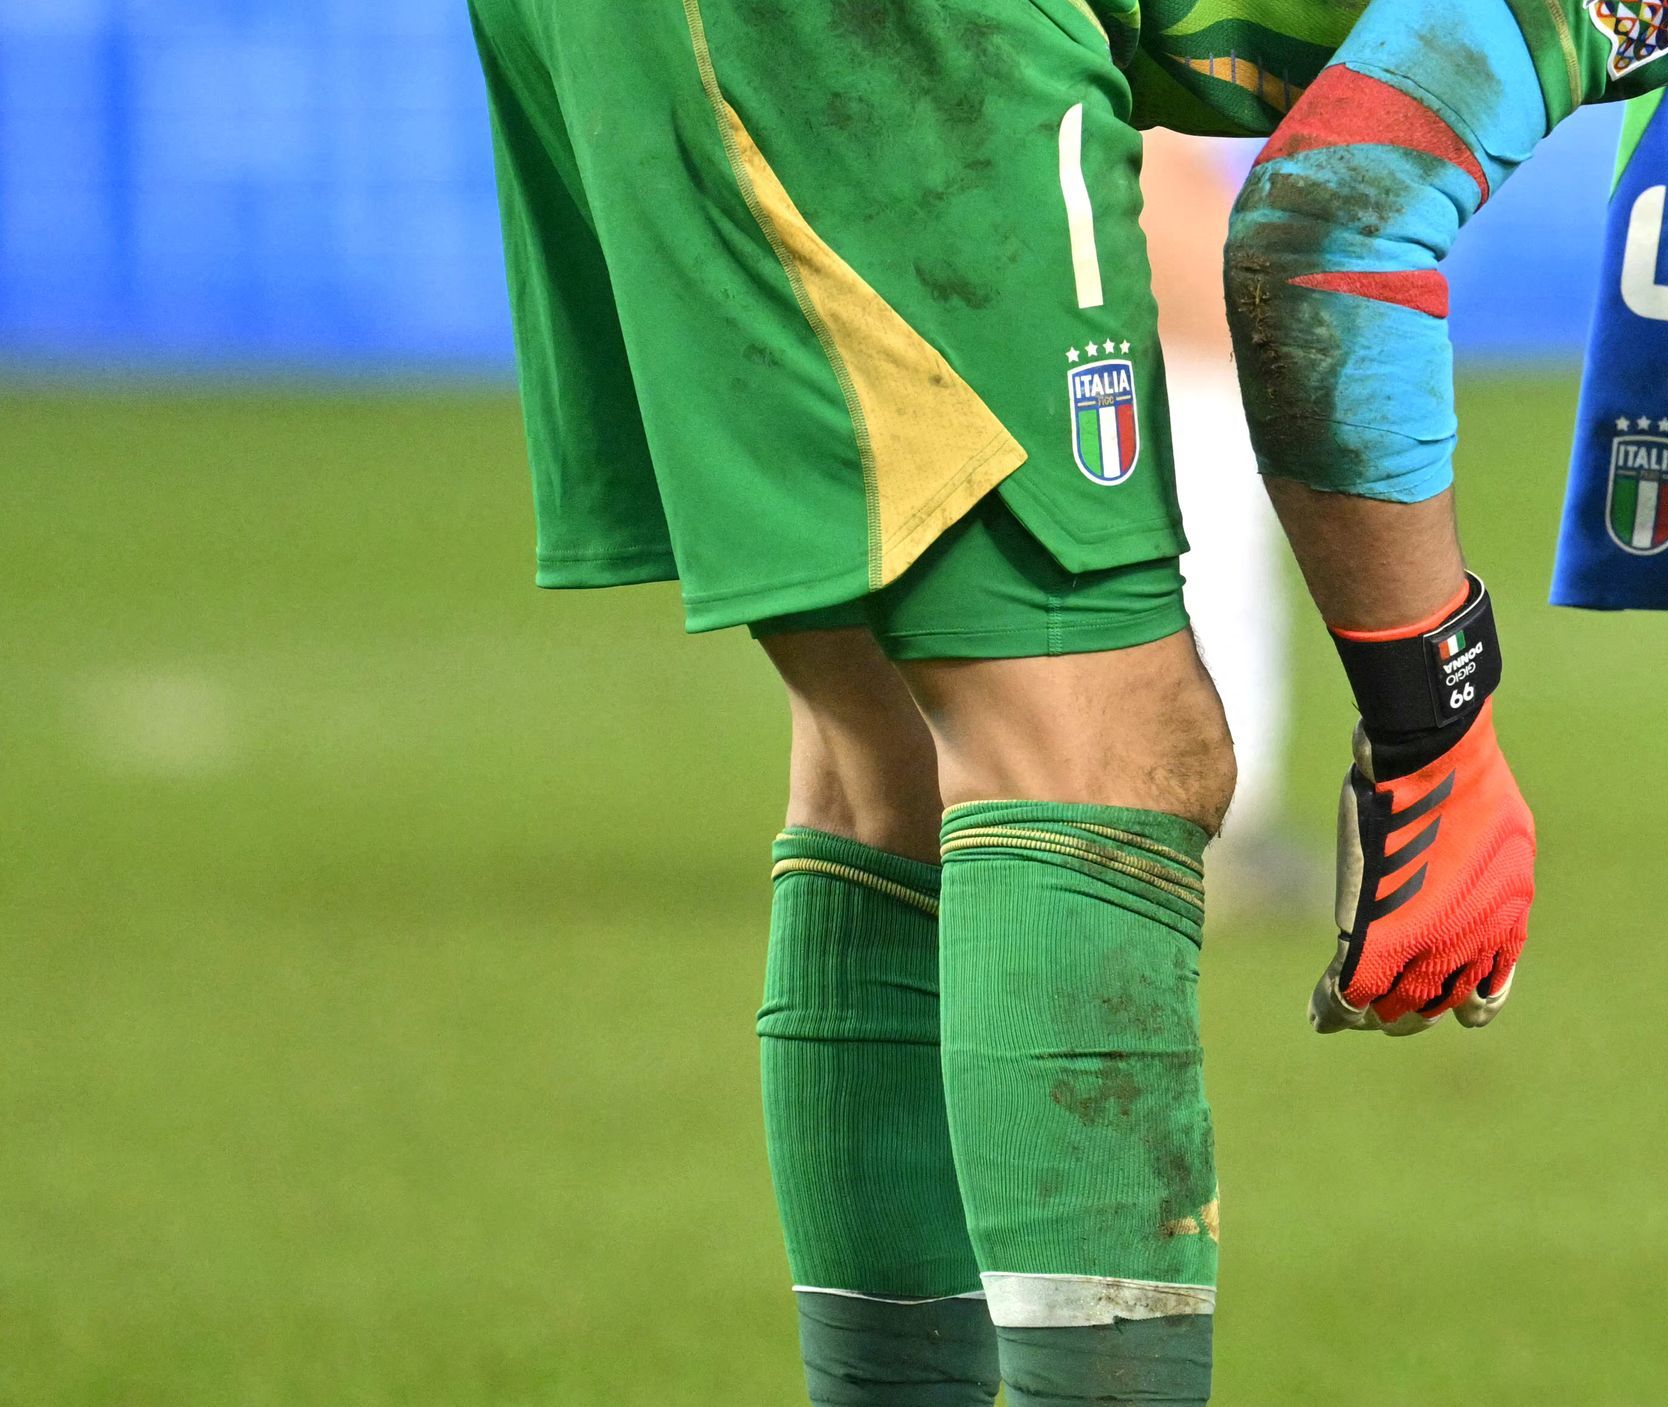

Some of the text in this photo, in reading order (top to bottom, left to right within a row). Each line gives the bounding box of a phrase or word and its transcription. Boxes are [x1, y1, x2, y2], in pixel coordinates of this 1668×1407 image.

[1058, 102, 1104, 309] 1
[1074, 369, 1131, 399] ITALIA
[1443, 641, 1484, 674] DONNA
[1445, 661, 1476, 686] GIGIO
